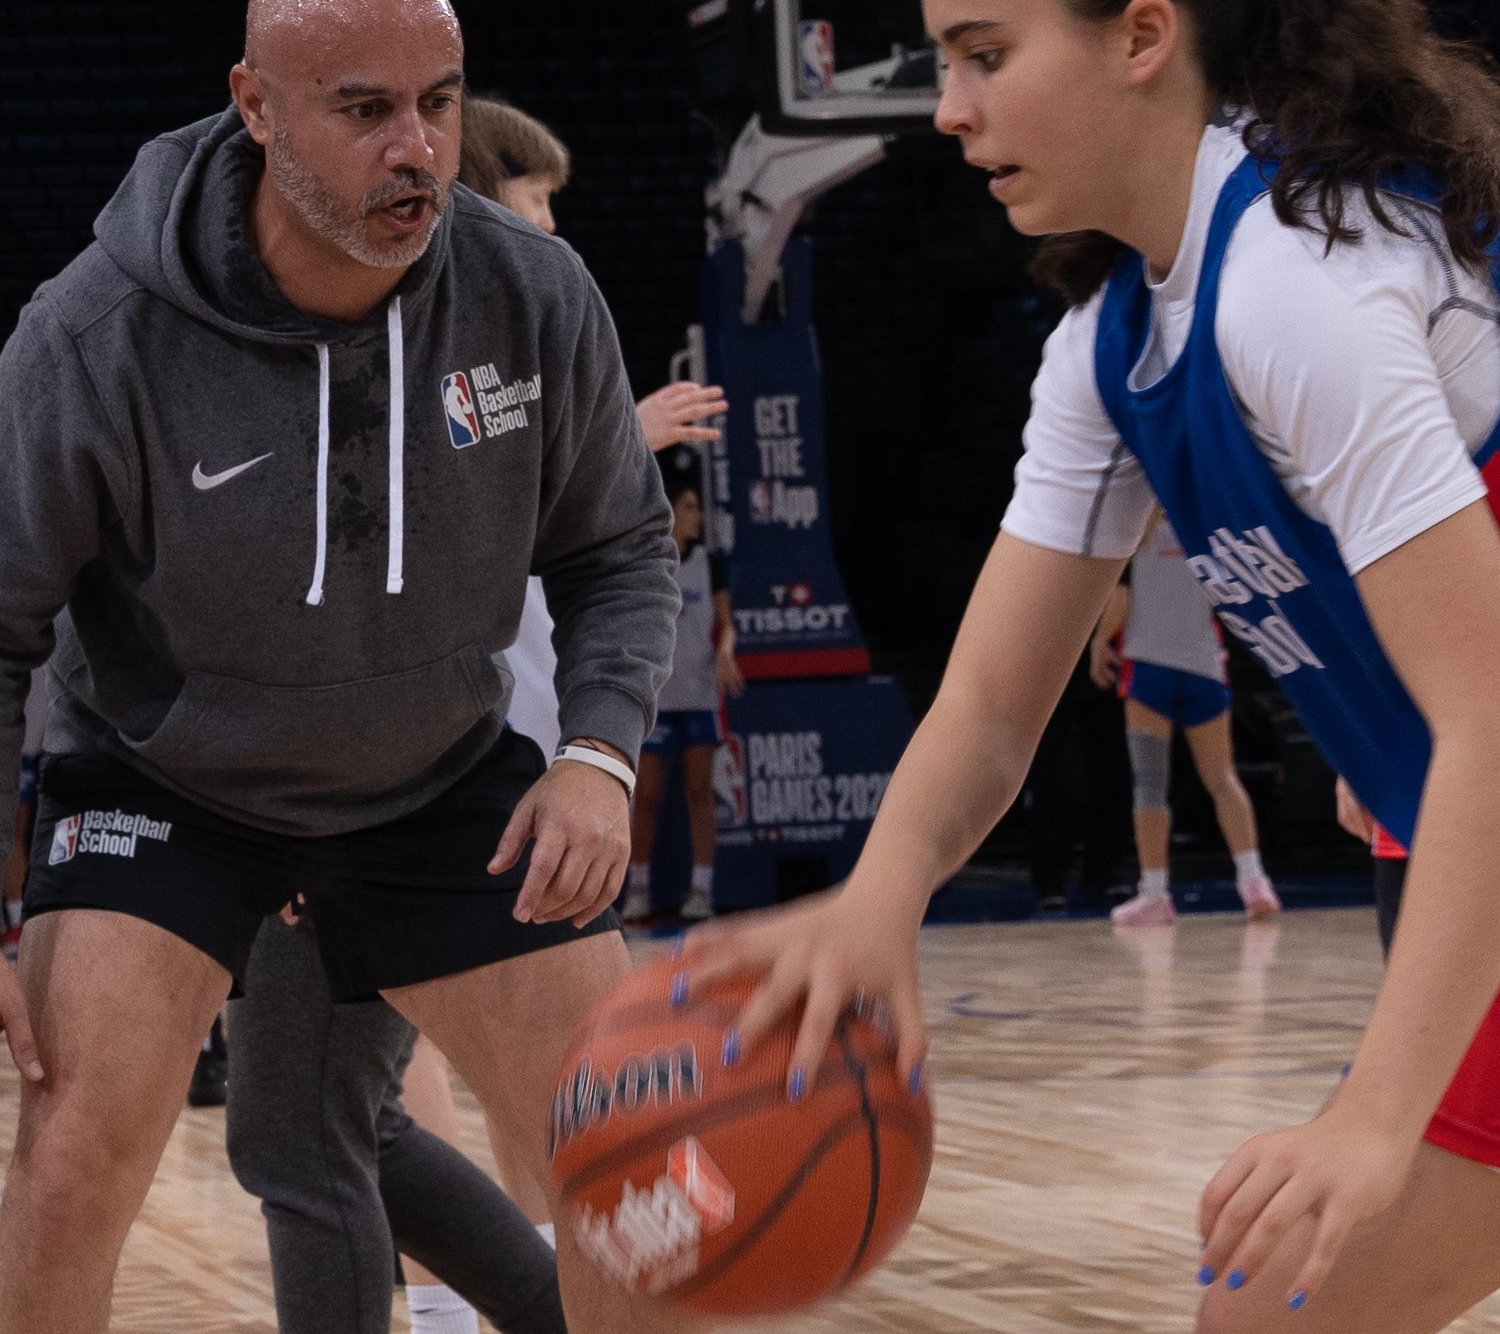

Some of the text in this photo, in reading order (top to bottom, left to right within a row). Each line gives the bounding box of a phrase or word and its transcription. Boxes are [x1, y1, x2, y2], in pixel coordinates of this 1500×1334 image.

[470, 363, 501, 392] NBA
[477, 374, 542, 415] Basketball
[483, 404, 529, 438] School
[754, 394, 800, 437] GET
[756, 437, 804, 478] THE
[735, 603, 850, 634] TISSOT
[748, 731, 823, 778] PARIS
[752, 774, 833, 824] GAMES
[835, 772, 892, 820] 202
[78, 828, 136, 858] School
[83, 809, 172, 842] Basketball
